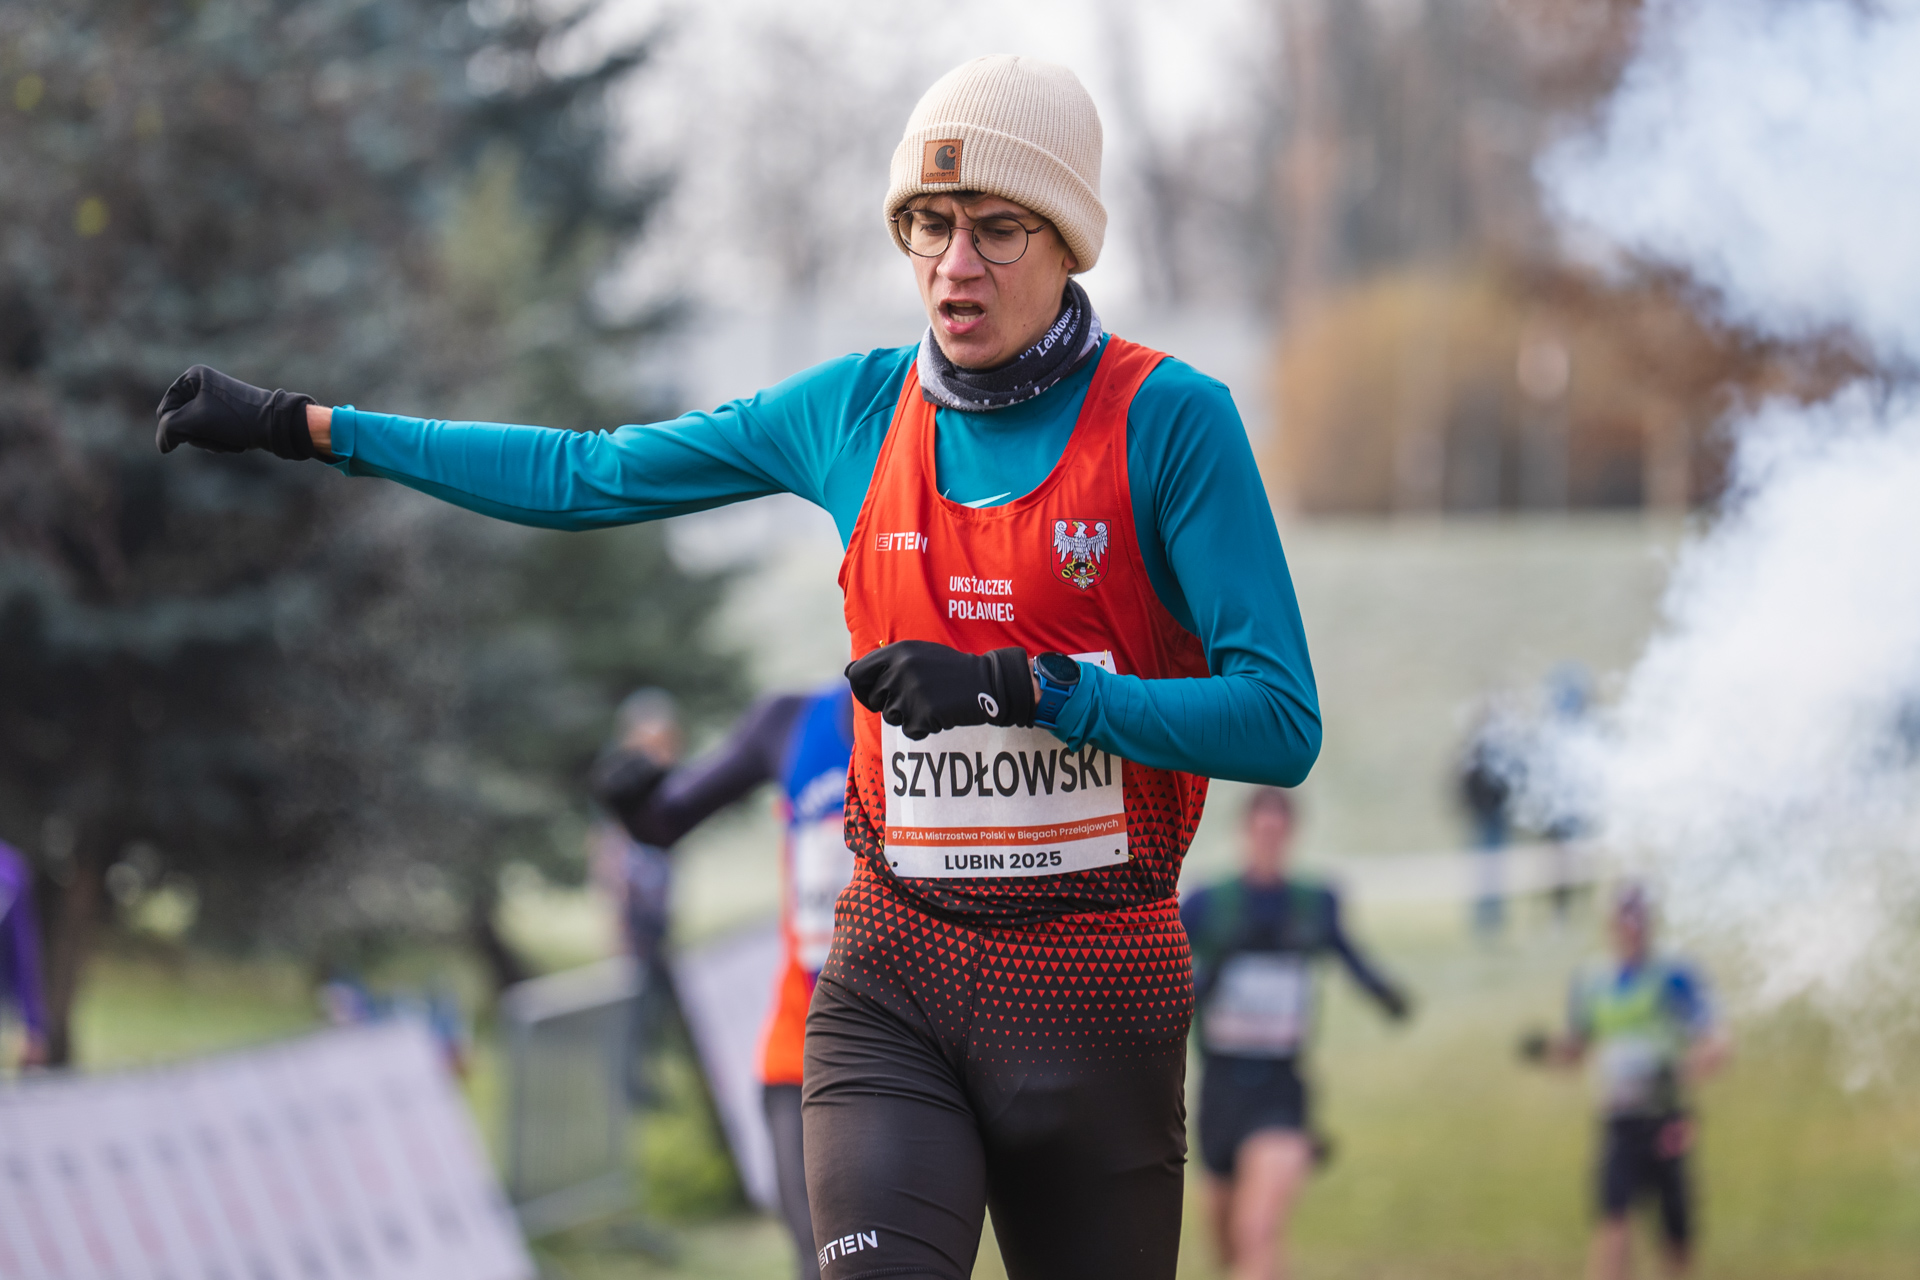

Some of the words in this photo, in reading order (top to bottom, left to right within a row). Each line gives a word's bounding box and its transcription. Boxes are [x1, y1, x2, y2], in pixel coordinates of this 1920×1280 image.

[948, 599, 1015, 622] POŁANIEC
[891, 746, 1112, 798] SZYDŁOWSKI
[892, 830, 904, 840] 97.
[906, 831, 924, 840] PZLA
[925, 831, 978, 841] Mistrzostwa
[980, 830, 1006, 840] Polski
[1007, 832, 1016, 840] w
[1017, 828, 1058, 842] Biegach
[944, 854, 1005, 870] LUBIN
[1009, 850, 1062, 870] 2025
